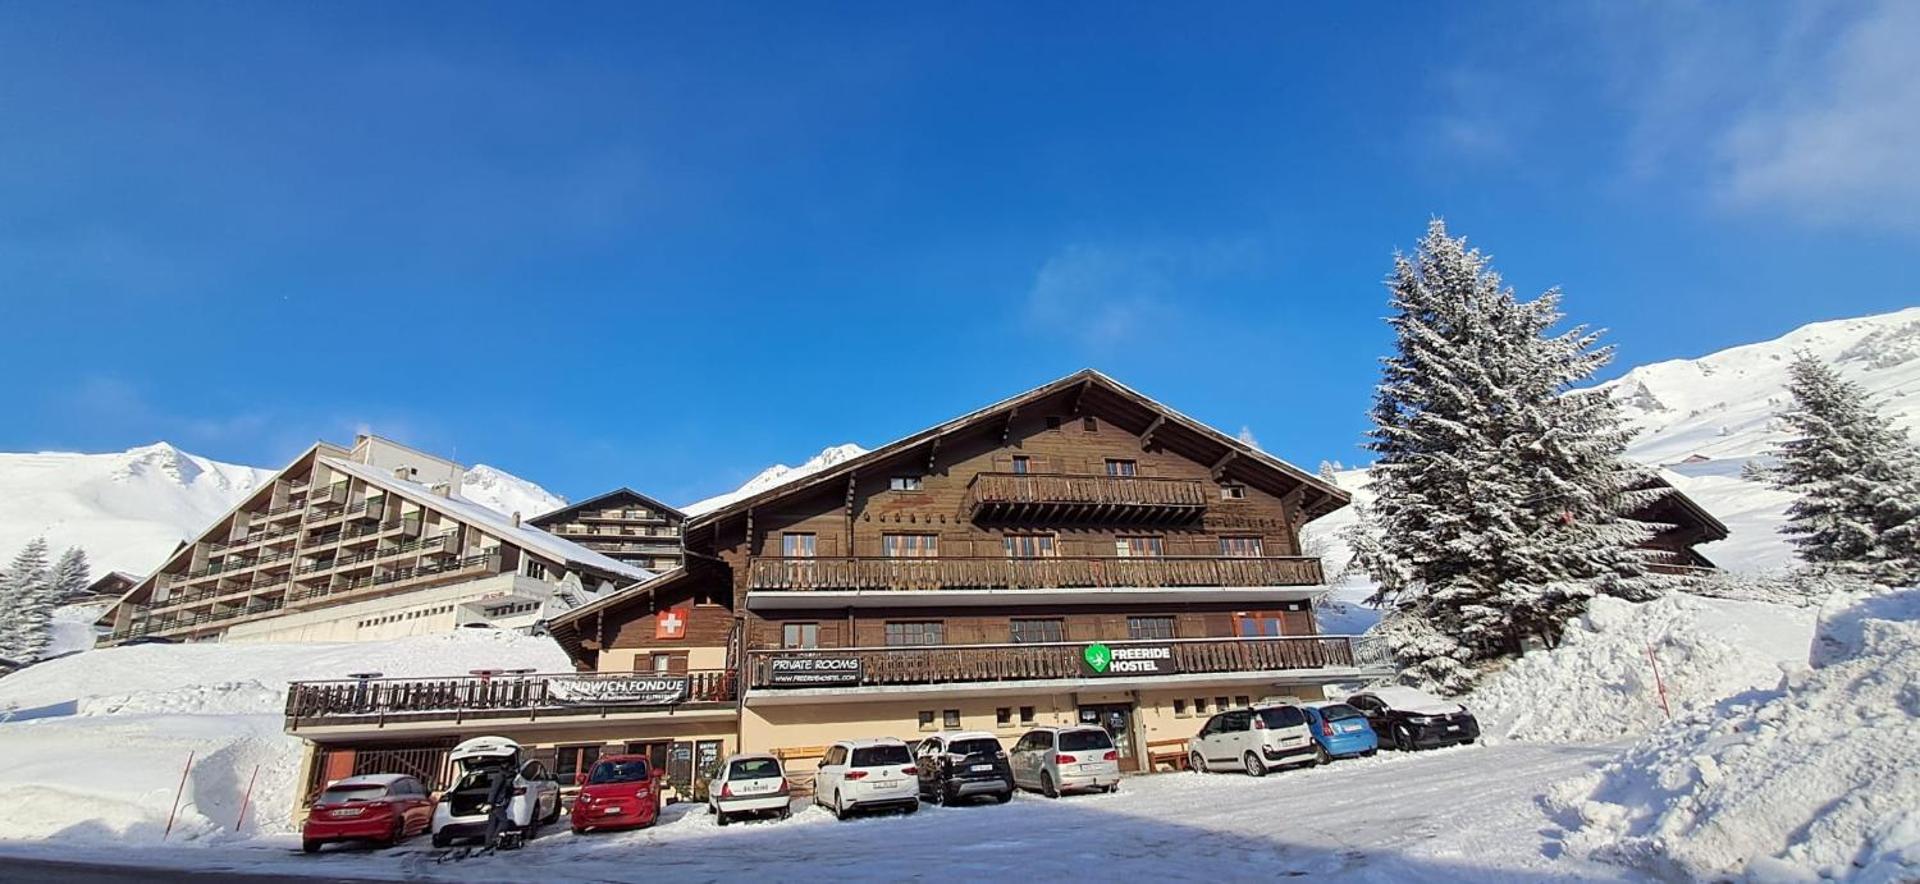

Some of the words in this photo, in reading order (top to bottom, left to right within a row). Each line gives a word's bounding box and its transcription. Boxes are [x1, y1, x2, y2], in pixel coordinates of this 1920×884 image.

[1110, 648, 1170, 660] FREERIDE
[772, 660, 812, 670] PRIVATE
[815, 659, 858, 669] ROOMS
[1110, 660, 1158, 672] HOSTEL
[629, 680, 685, 692] FONDUE
